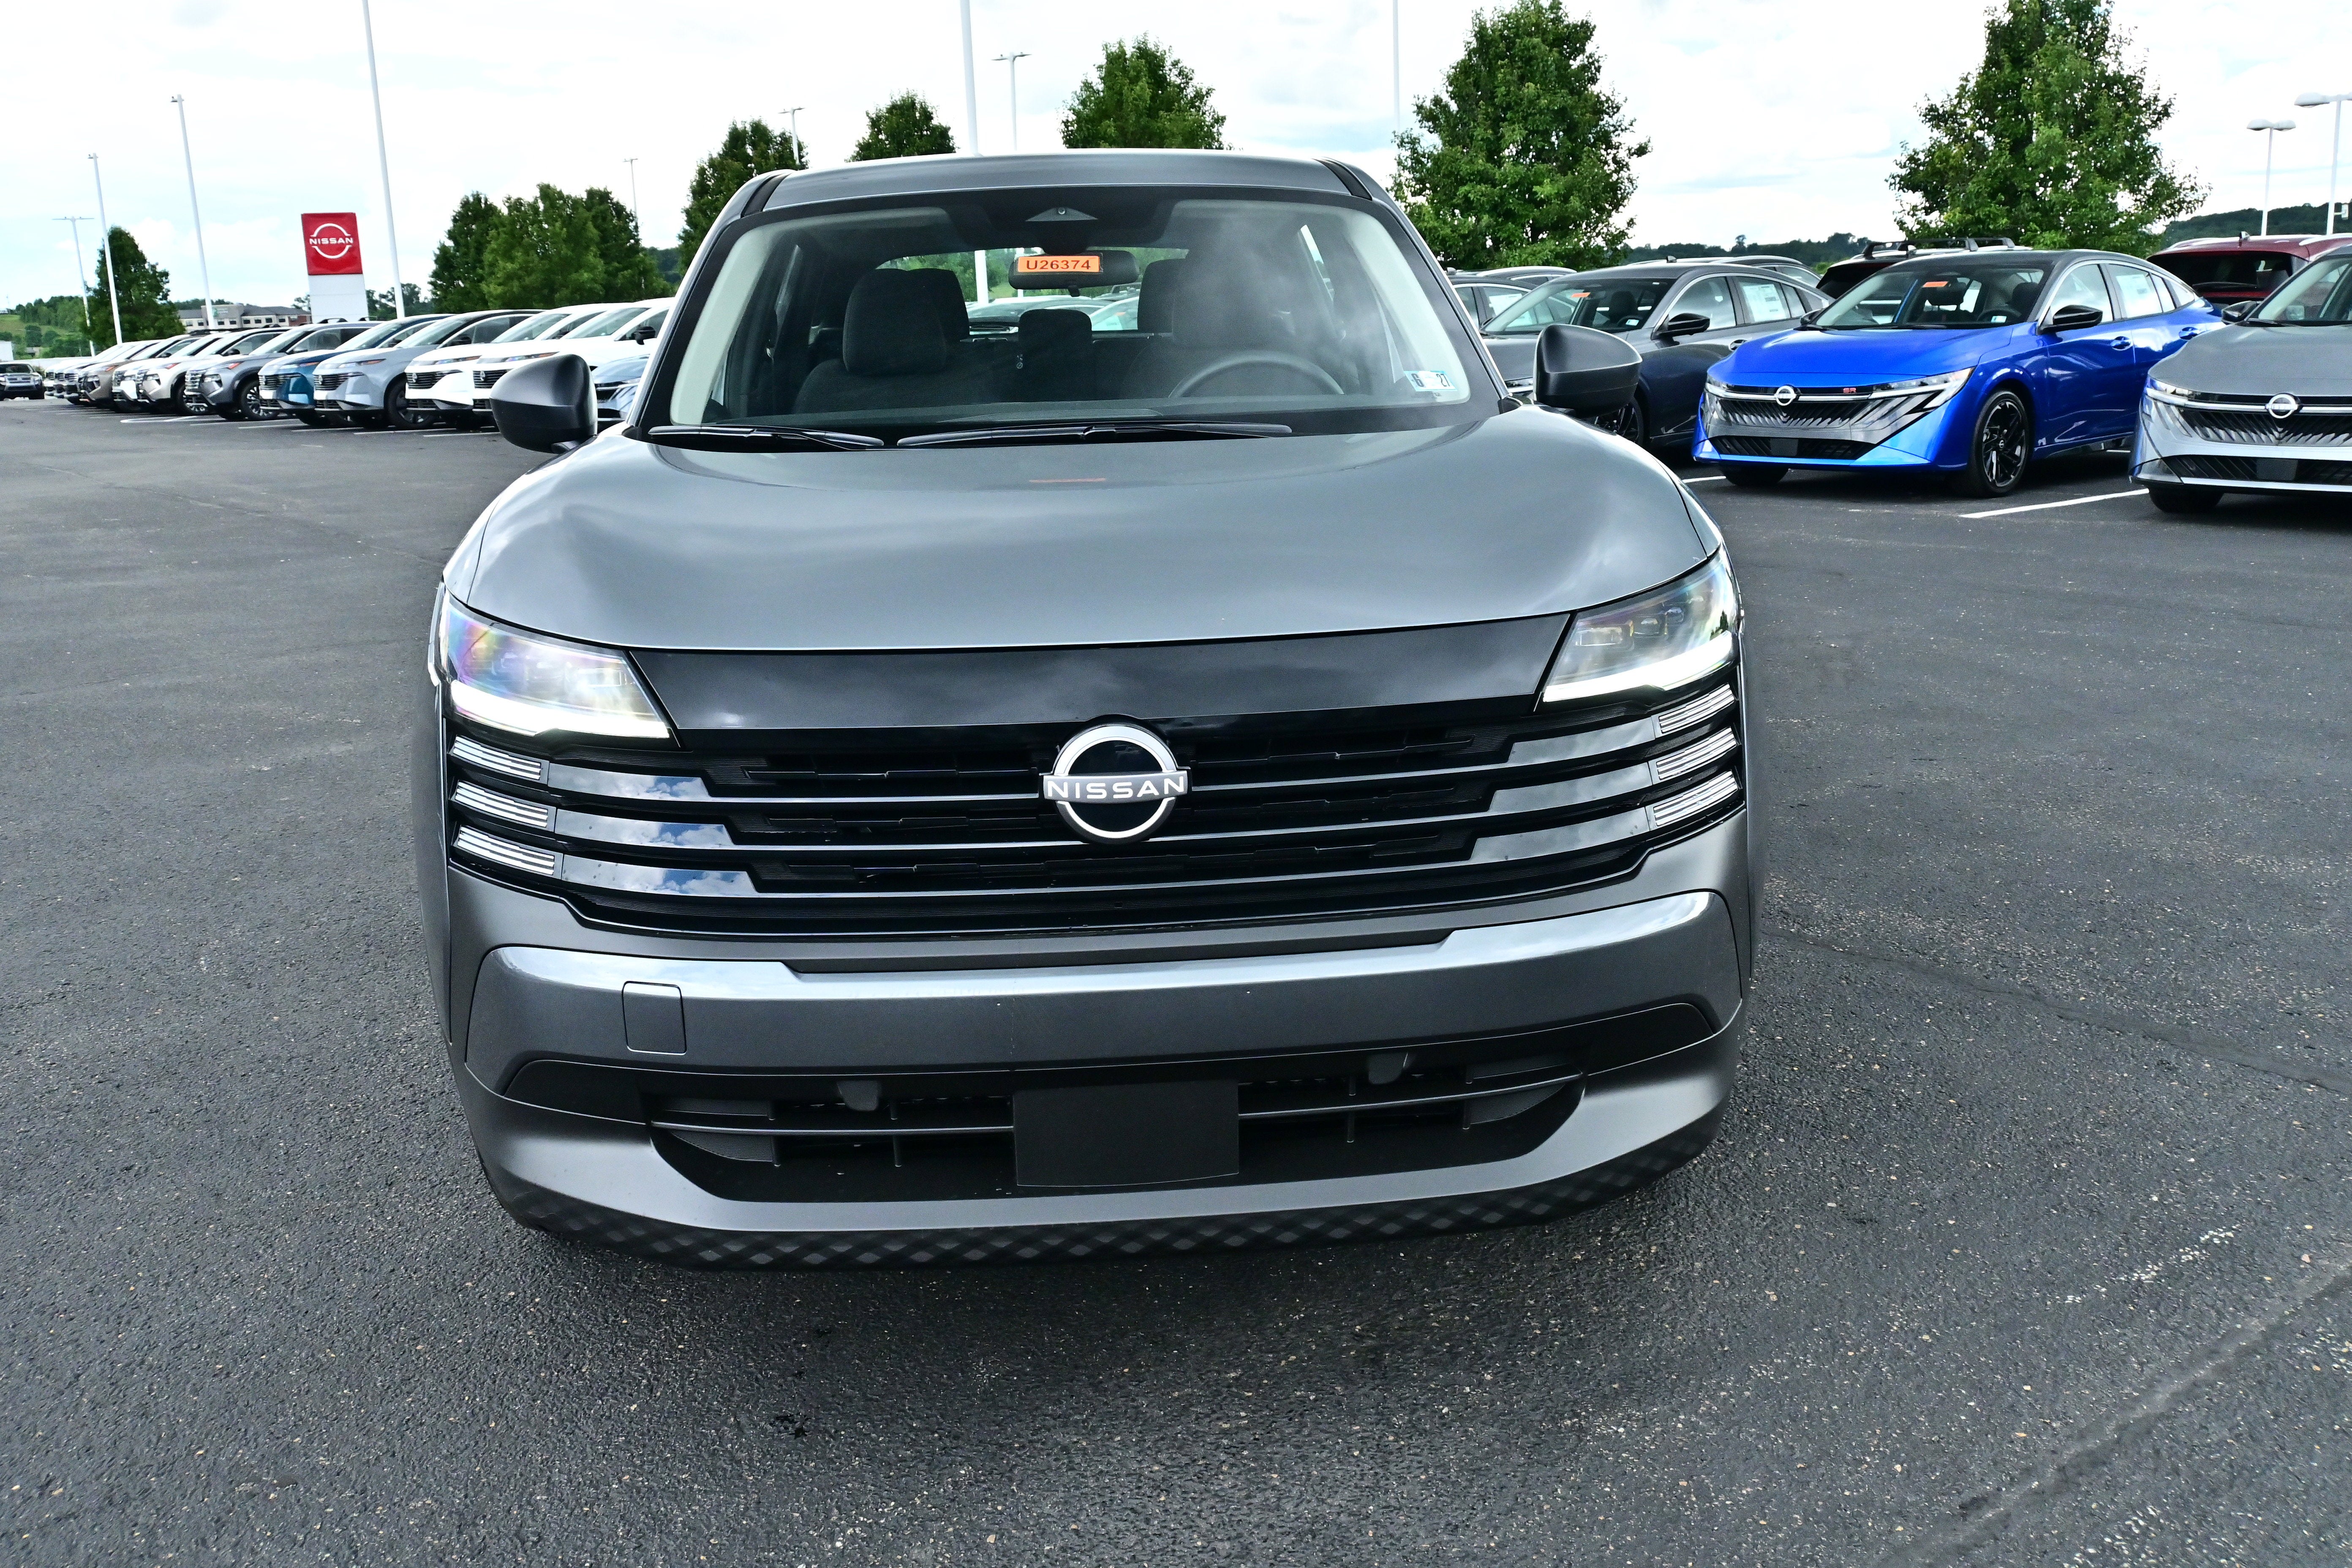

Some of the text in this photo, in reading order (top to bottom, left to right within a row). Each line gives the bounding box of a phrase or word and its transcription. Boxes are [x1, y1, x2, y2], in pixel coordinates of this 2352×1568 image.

[1026, 260, 1091, 270] U26374
[1411, 373, 1450, 387] 6 27
[1047, 776, 1184, 799] NISSAN
